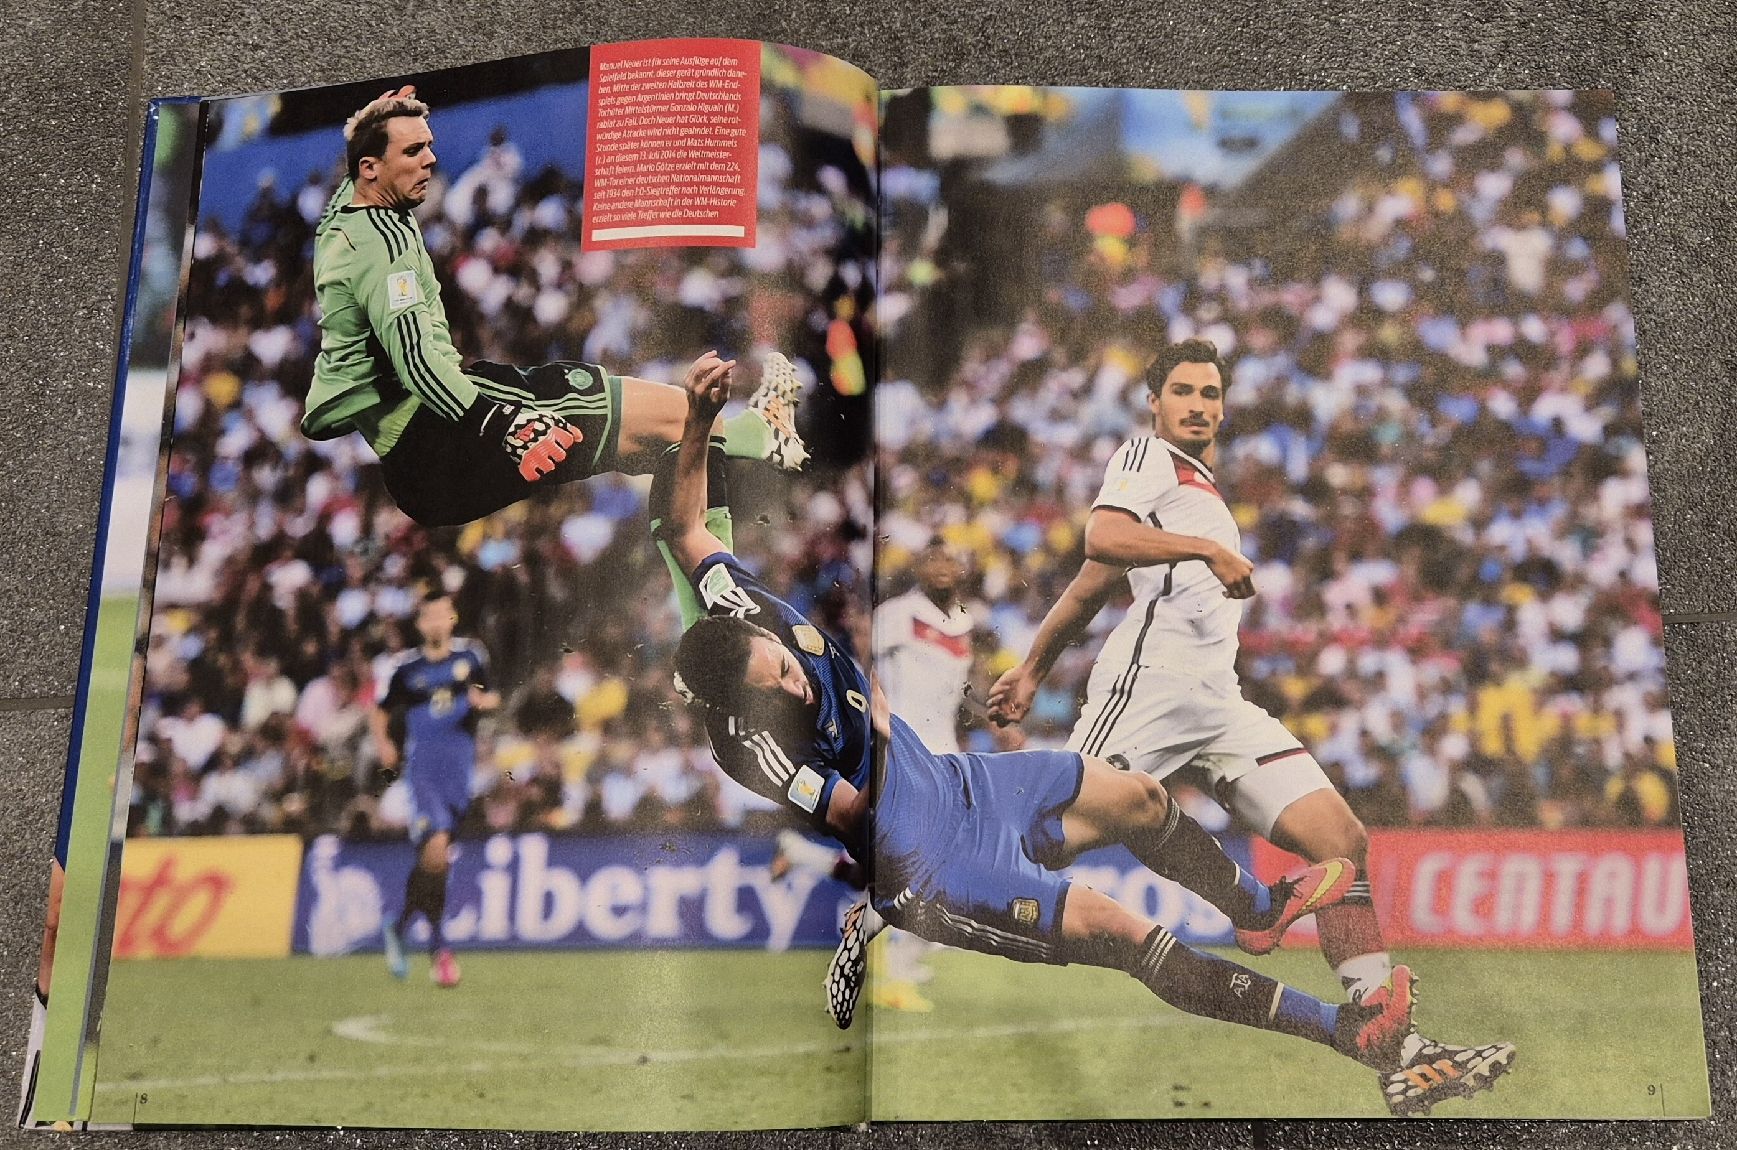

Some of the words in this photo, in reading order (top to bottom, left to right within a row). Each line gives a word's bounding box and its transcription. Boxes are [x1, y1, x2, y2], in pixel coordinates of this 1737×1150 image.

[623, 60, 642, 68] Neuer
[643, 58, 651, 67] ist
[652, 57, 661, 67] für
[662, 57, 679, 66] seine
[680, 56, 709, 66] Ausflüge
[710, 56, 722, 66] auf
[723, 57, 738, 66] dem
[600, 72, 627, 83] Spielfeld
[656, 69, 676, 78] dieser
[676, 68, 694, 78] gerät
[695, 68, 727, 78] gründlich
[612, 83, 629, 92] Mitte
[631, 82, 641, 91] der
[641, 81, 667, 90] zweiten
[668, 79, 695, 88] Halbzeit
[696, 79, 708, 88] des
[598, 96, 616, 106] spiels
[616, 95, 636, 105] gegen
[637, 92, 675, 103] Argentinien
[675, 91, 695, 101] bringt
[696, 91, 741, 100] Deutschlands
[670, 103, 697, 112] Gonzalo
[724, 103, 739, 113] (M.)
[596, 119, 615, 129] rabiat
[615, 120, 624, 128] zu
[624, 117, 638, 126] Fall.
[639, 115, 656, 125] Doch
[656, 115, 676, 124] Neuer
[676, 114, 689, 123] hat
[709, 115, 728, 123] seine
[647, 127, 662, 137] wird
[662, 126, 679, 135] nicht
[714, 126, 730, 135] Eine
[730, 127, 747, 137] gute
[596, 143, 618, 152] Stunde
[619, 142, 640, 151] später
[673, 138, 686, 147] und
[686, 138, 704, 147] Mats
[704, 138, 738, 147] Hummels
[606, 154, 615, 163] an
[615, 153, 639, 163] diesem
[648, 150, 660, 160] Juli
[661, 150, 676, 159] 2014
[677, 149, 688, 159] die
[688, 149, 732, 159] Weltmeister-
[595, 166, 615, 176] schaft
[636, 163, 656, 172] Mario
[656, 161, 675, 172] Götze
[675, 161, 696, 171] erzielt
[697, 161, 709, 171] mit
[709, 161, 726, 171] dem
[619, 177, 636, 185] einer
[636, 174, 670, 184] deutschen
[671, 172, 741, 184] Nationalmannschaft
[593, 189, 606, 199] seit
[606, 188, 620, 198] 1934
[621, 187, 634, 197] den
[681, 185, 698, 194] nach
[592, 202, 610, 211] Keine
[611, 200, 634, 209] andere
[634, 197, 673, 208] Mannschaft
[674, 197, 681, 206] in
[681, 197, 693, 206] der
[694, 197, 737, 207] WM-Historie
[592, 213, 612, 223] erzielt
[621, 211, 637, 220] viele
[638, 209, 659, 220] Treffer
[659, 209, 671, 218] wie
[671, 208, 682, 218] die
[683, 208, 719, 218] Deutschen
[1411, 851, 1688, 936] CENTAU
[1647, 1084, 1656, 1096] 9
[140, 1092, 148, 1105] 8
